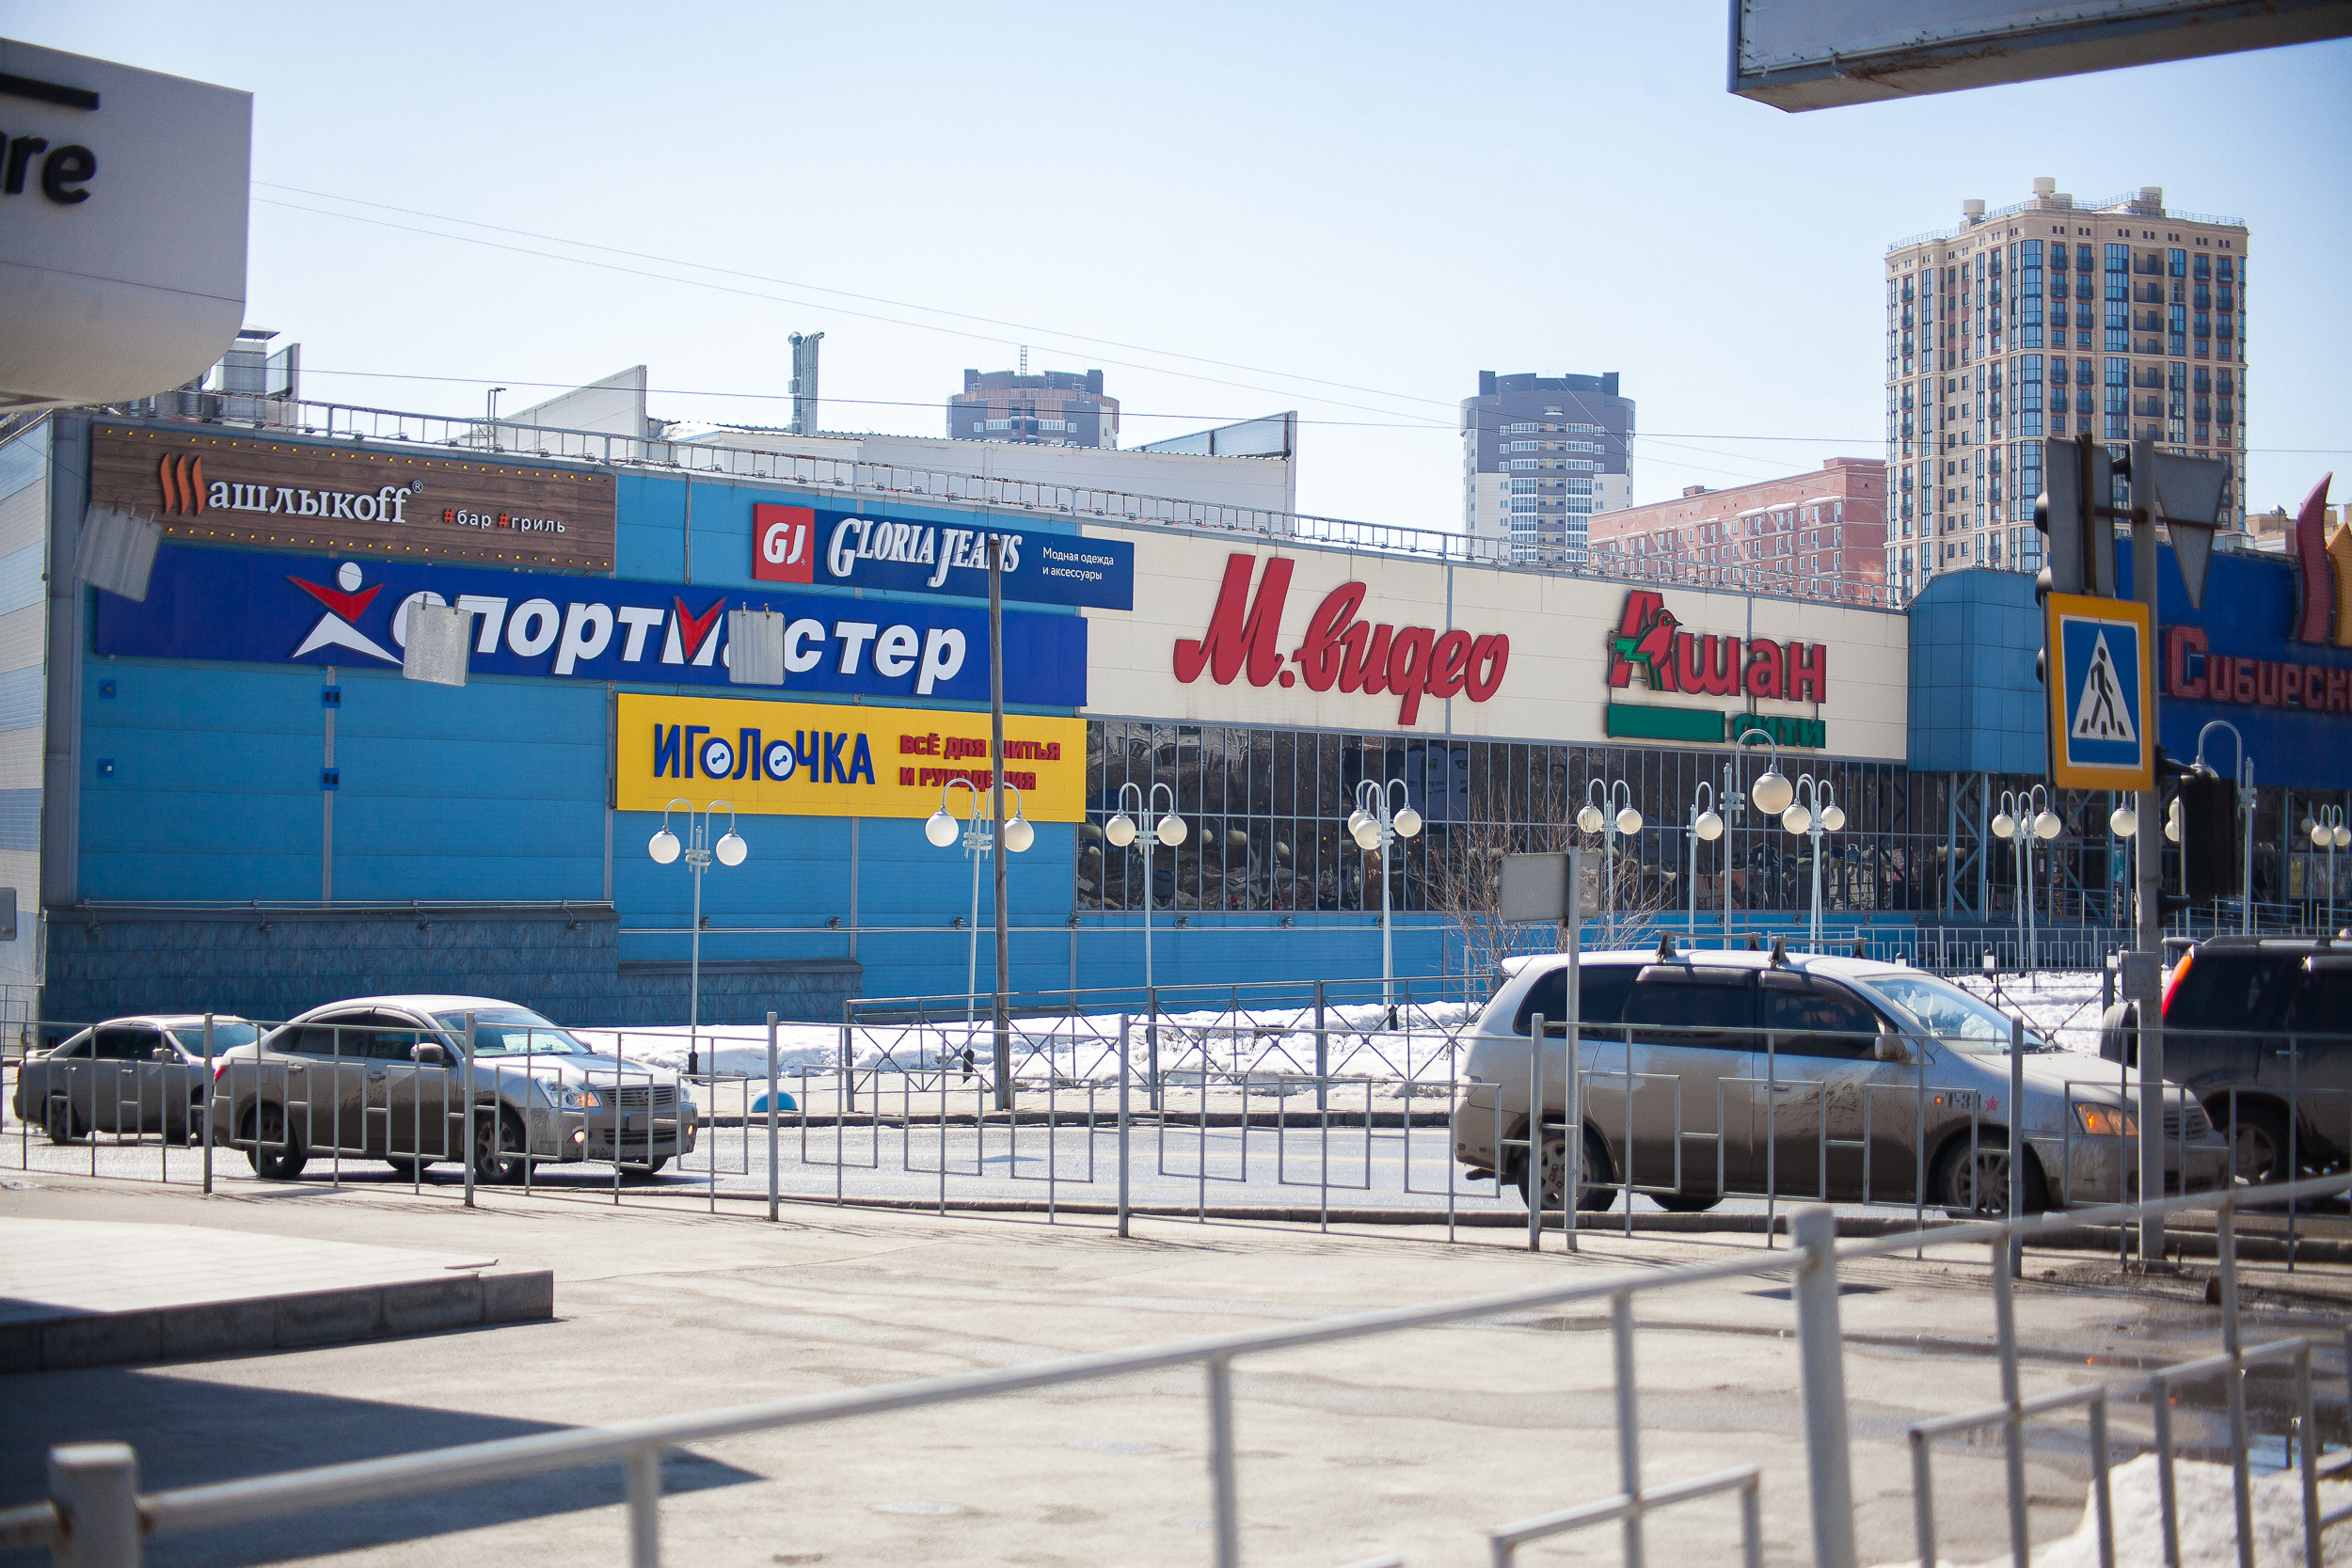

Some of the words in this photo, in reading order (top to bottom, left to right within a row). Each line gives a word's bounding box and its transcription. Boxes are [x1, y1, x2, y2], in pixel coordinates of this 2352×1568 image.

[0, 130, 97, 206] re
[443, 508, 491, 530] #бар
[499, 513, 565, 533] #гриль
[763, 522, 806, 565] GJ
[1042, 546, 1079, 562] Модная
[1080, 553, 1114, 566] одежда
[1042, 566, 1049, 576] и
[1050, 567, 1103, 581] аксессуары
[2166, 625, 2352, 713] Сибирск
[899, 733, 940, 755] ВСЁ
[944, 737, 986, 760] ДЛЯ
[899, 767, 914, 786] И
